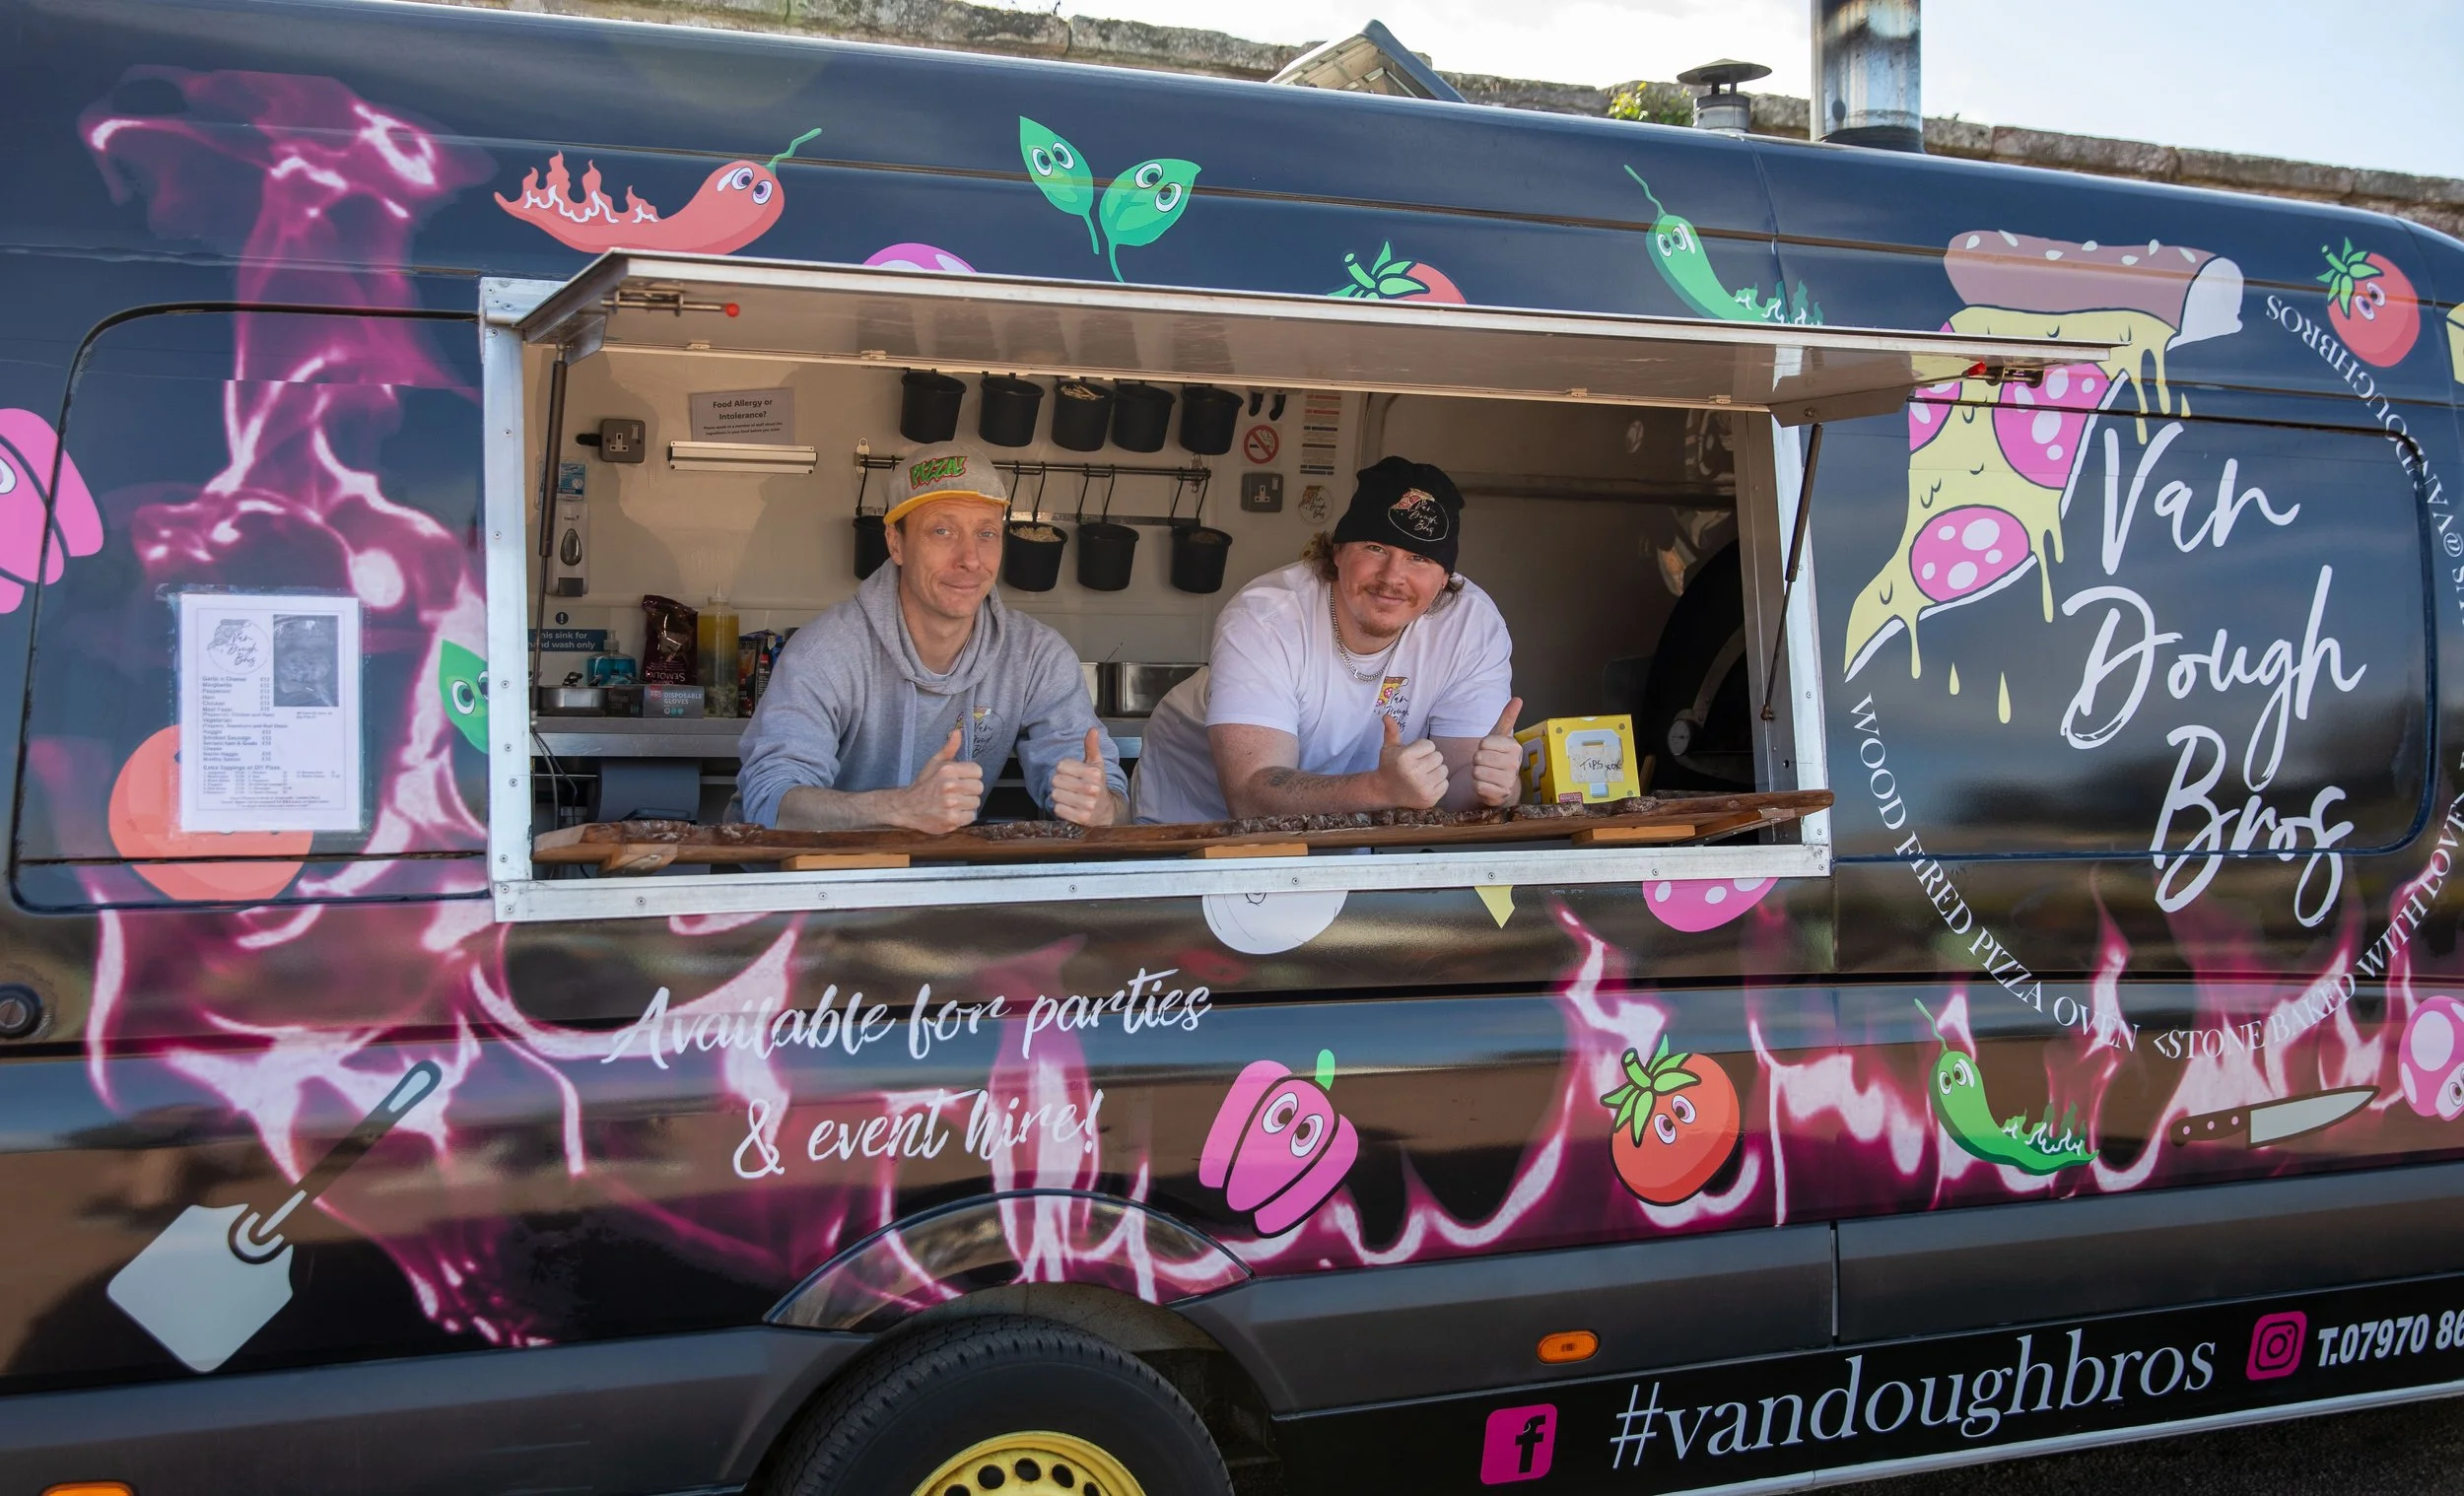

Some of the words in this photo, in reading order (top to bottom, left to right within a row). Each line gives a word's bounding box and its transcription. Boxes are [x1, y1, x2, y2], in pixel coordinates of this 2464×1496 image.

[713, 400, 732, 409] Food
[734, 399, 762, 408] Allergy
[719, 411, 767, 420] Intolerance?
[910, 456, 968, 490] PIZZA!
[2101, 421, 2300, 576] Van
[577, 641, 595, 650] only
[2060, 564, 2367, 791] Dough
[1850, 692, 1907, 830] WOOD
[1893, 831, 1972, 935] FIRED
[1968, 926, 2043, 1013] PIZZA
[2053, 996, 2140, 1052] OVEN
[2267, 973, 2357, 1045] BAKED
[2356, 892, 2429, 978] WITH
[2150, 724, 2355, 927] Bros
[601, 985, 896, 1069] Available
[909, 984, 1011, 1059] for
[1022, 968, 1212, 1059] parties
[733, 1098, 785, 1179] &
[808, 1088, 982, 1160] event
[964, 1088, 1104, 1161] hire!
[2318, 1314, 2430, 1367] T.07970
[1609, 1327, 2217, 1468] #vandoughbros
